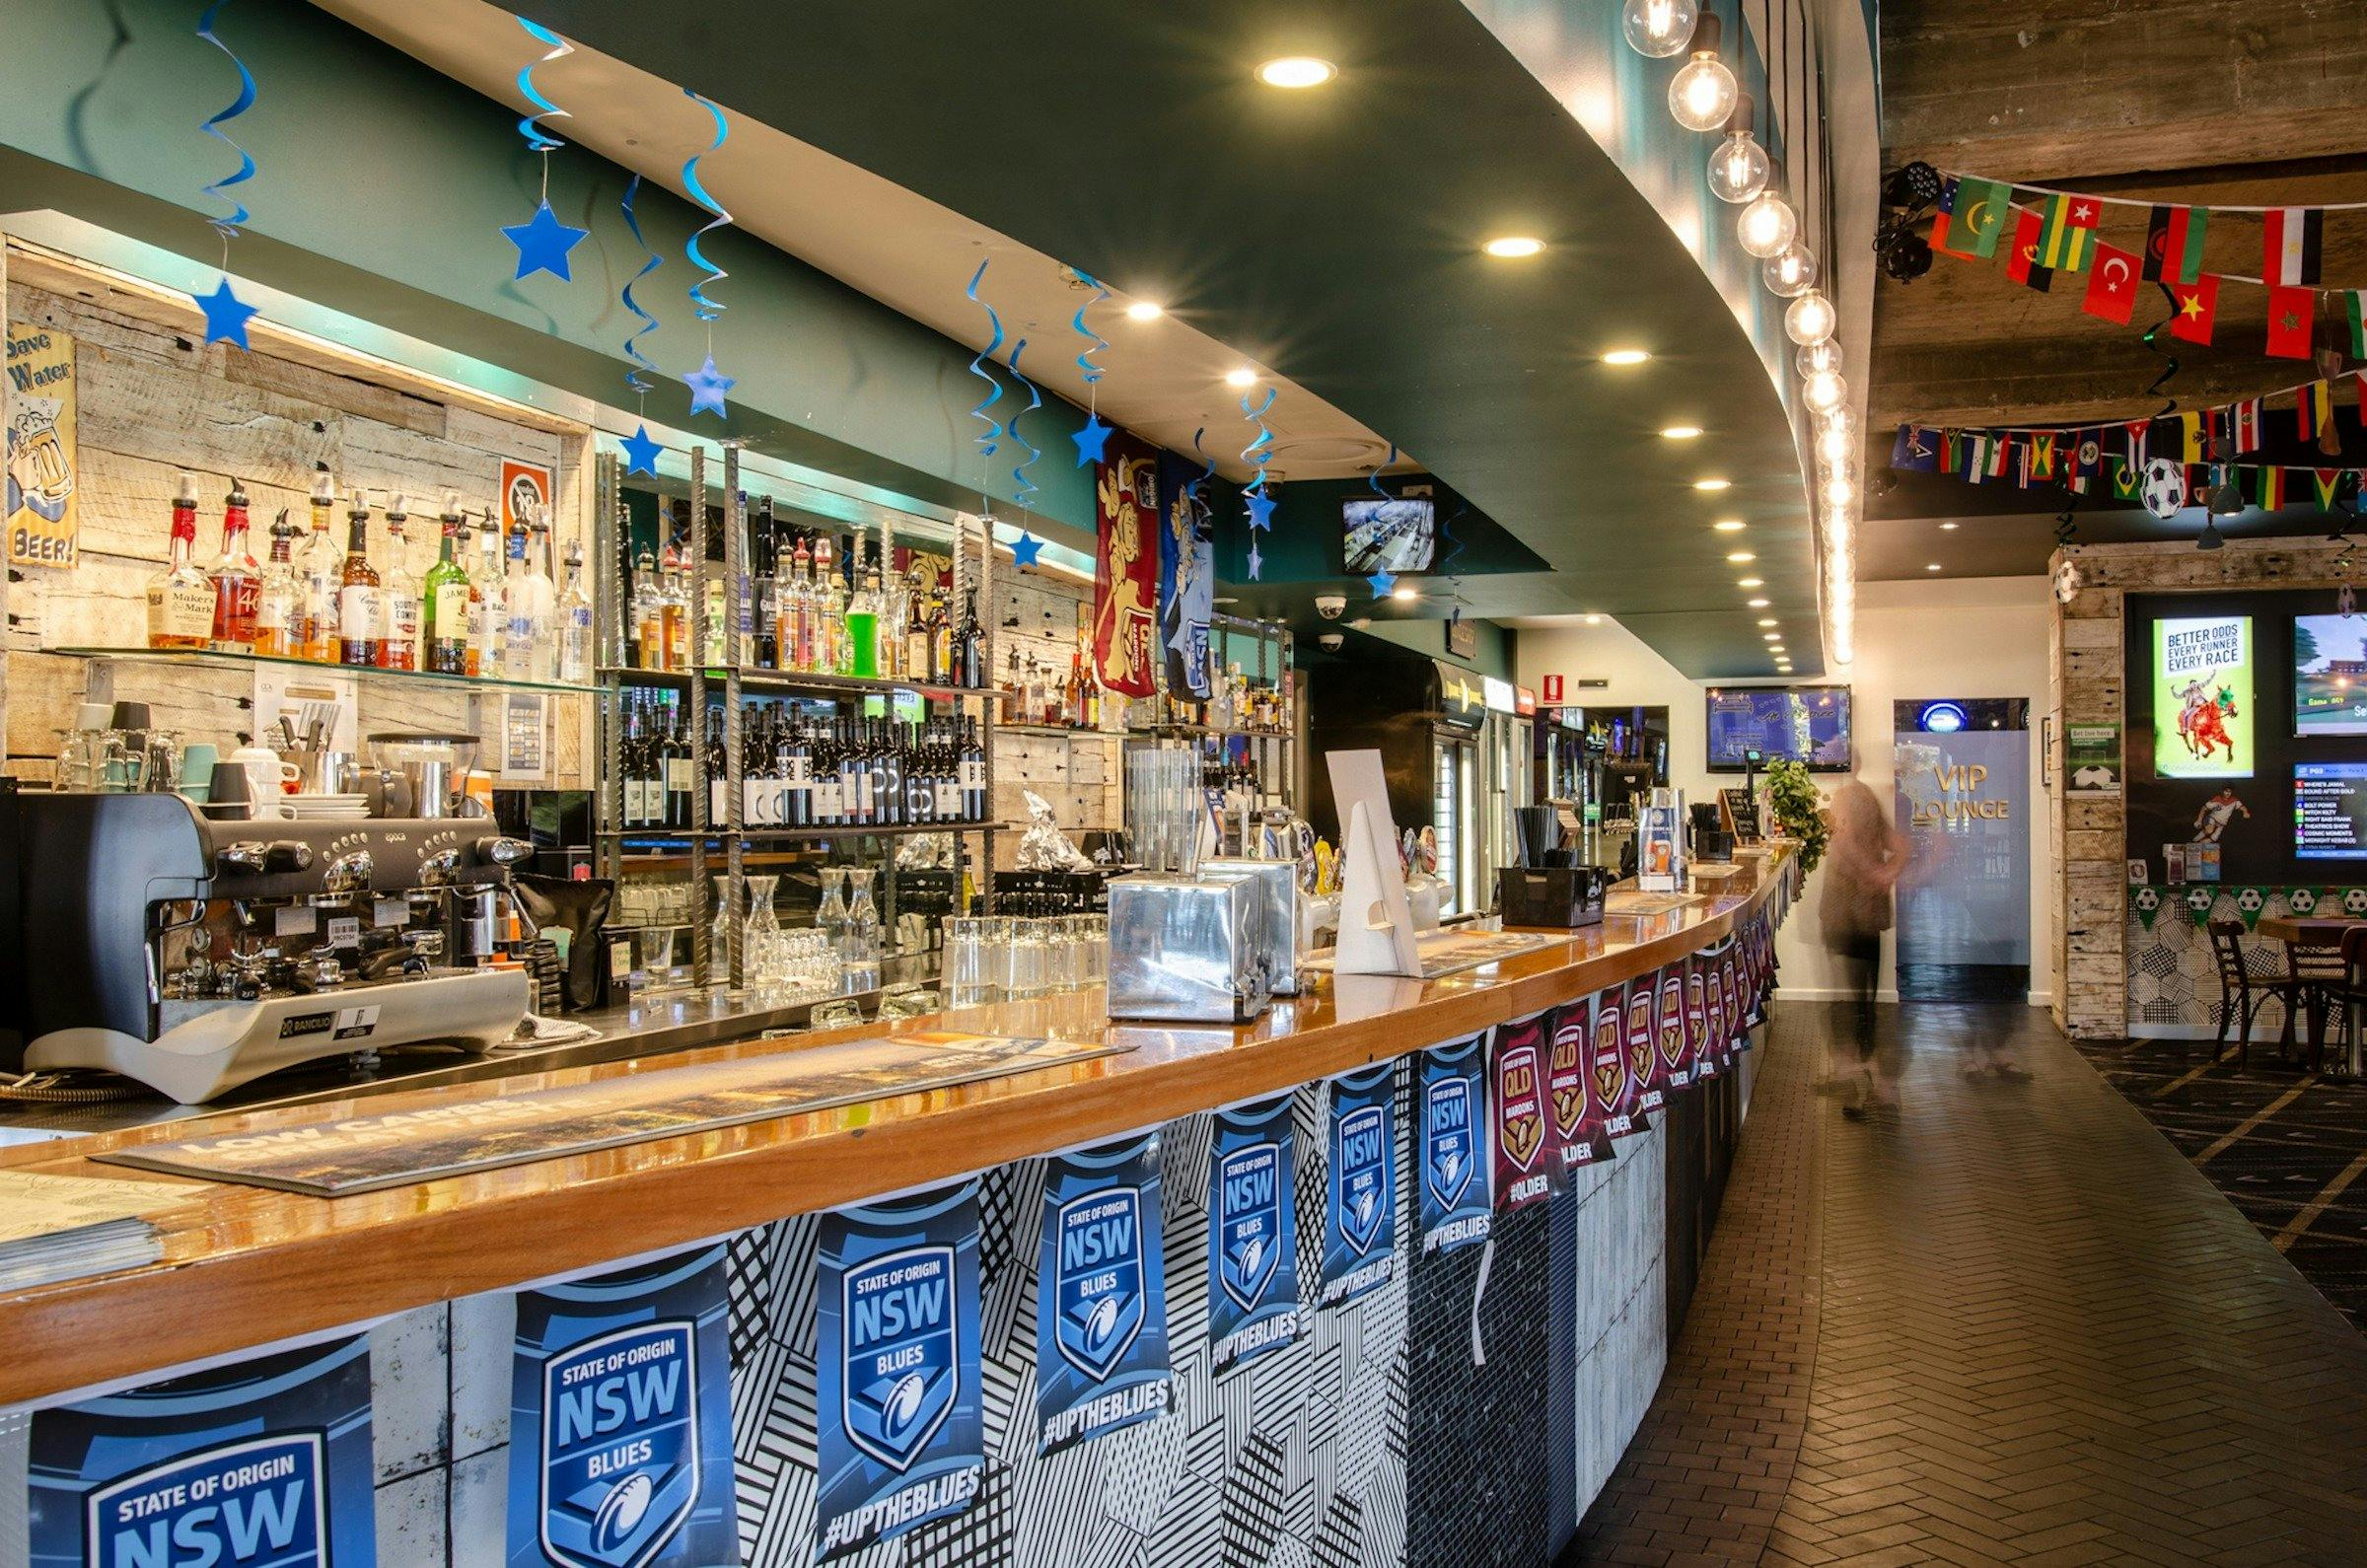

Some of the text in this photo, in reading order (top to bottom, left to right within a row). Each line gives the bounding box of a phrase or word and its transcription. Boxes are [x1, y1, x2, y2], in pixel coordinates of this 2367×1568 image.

[8, 361, 71, 392] Water
[14, 528, 74, 563] BEER!
[186, 604, 213, 613] Mark
[444, 590, 467, 600] JAME
[2168, 624, 2238, 647] BETTER ODDS
[2169, 638, 2238, 659] EVERY RUNNER
[2169, 648, 2238, 672] EVERY RACE
[1934, 764, 1988, 793] VIP
[1913, 800, 2010, 820] LOUNGE
[1553, 1042, 1577, 1071] QLD
[1504, 1066, 1532, 1099] QLD
[1432, 1097, 1467, 1134] NSW
[1604, 1114, 1632, 1136] LDER
[179, 1127, 323, 1155] LOW
[1343, 1128, 1381, 1172] NSW
[1438, 1136, 1459, 1153] BLUES
[1560, 1141, 1592, 1164] LDER
[1226, 1154, 1272, 1176] STATE OF ORIGIN
[1225, 1168, 1273, 1217] NSW
[1353, 1172, 1374, 1191] BLUES
[1510, 1174, 1548, 1203] #QLDER
[1067, 1199, 1129, 1228] STATE OF ORIGIN
[1237, 1217, 1263, 1240] BLUES
[1064, 1215, 1132, 1272] NSW
[857, 1260, 941, 1296] STATE OF ORIGIN
[1080, 1271, 1117, 1299] BLUES
[1322, 1254, 1394, 1304] #UPTHEBLUES
[854, 1278, 946, 1347] NSW
[1212, 1310, 1298, 1368] #UPTHEBLUES
[562, 1337, 677, 1386] STATE OF ORIGIN
[877, 1343, 925, 1376] BLUES
[557, 1359, 682, 1448] NSW
[1042, 1378, 1170, 1447] #UPTHEBLUES
[588, 1438, 653, 1479] BLUES
[118, 1454, 296, 1524] STATE OF ORIGIN
[113, 1478, 305, 1568] NSW
[823, 1463, 981, 1553] #UPTHEBLUES
